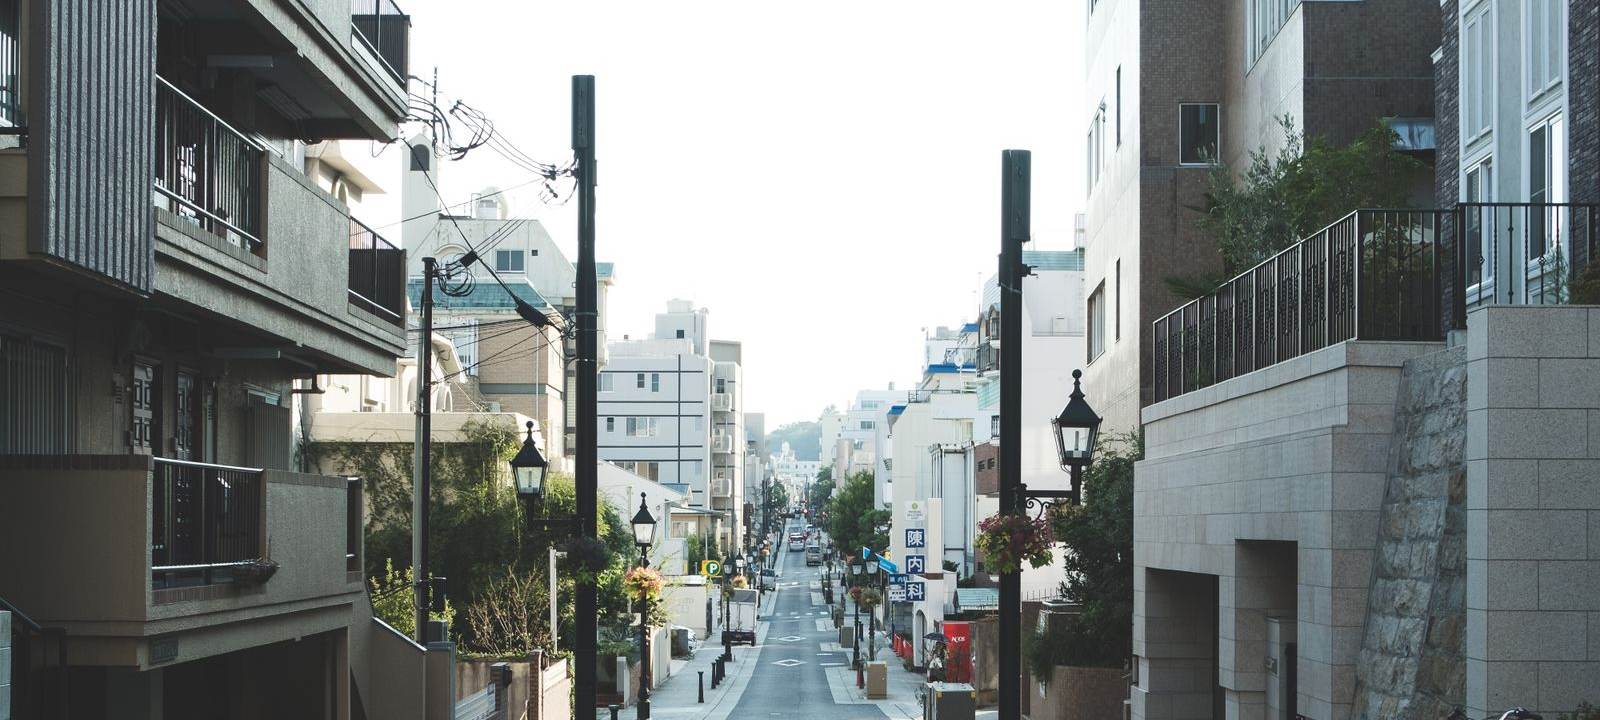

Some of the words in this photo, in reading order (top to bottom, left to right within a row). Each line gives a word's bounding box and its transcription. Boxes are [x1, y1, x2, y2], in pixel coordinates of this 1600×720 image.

[709, 563, 718, 574] P
[907, 529, 924, 600] 陳内科
